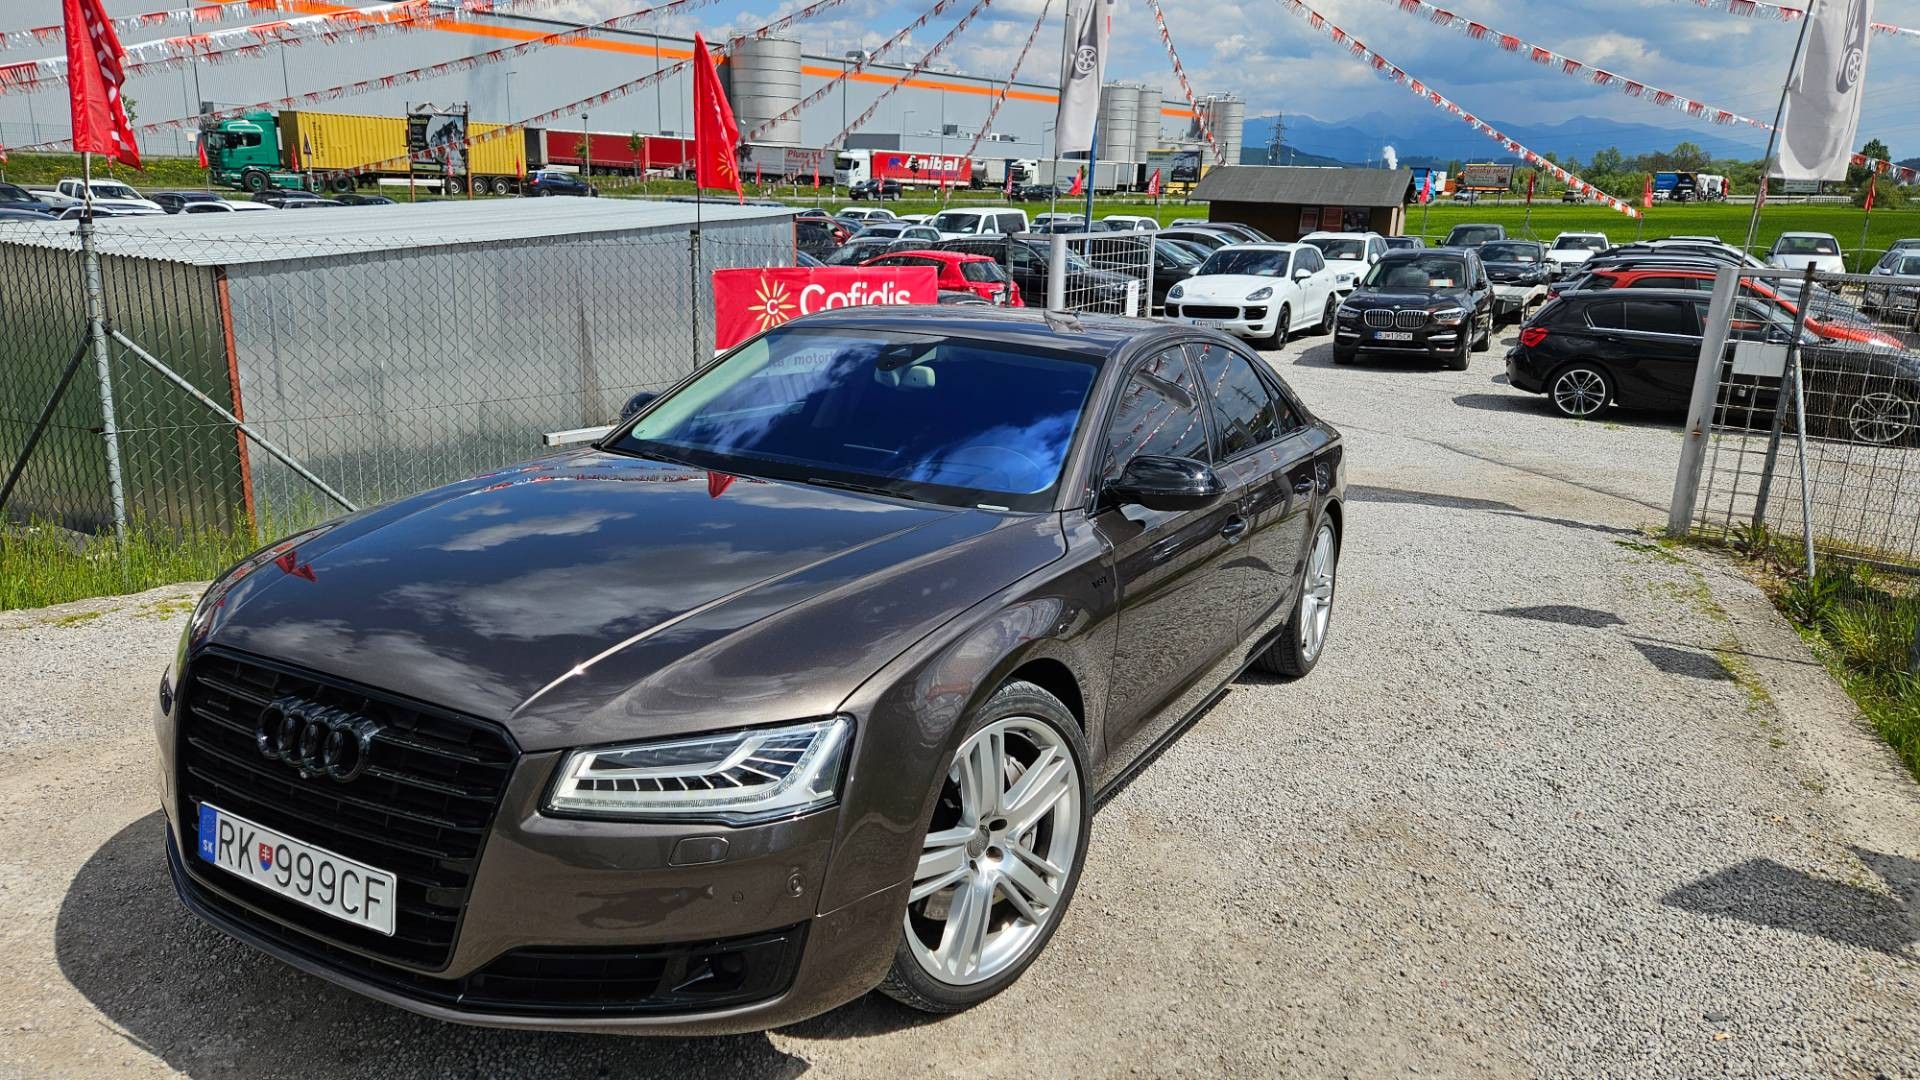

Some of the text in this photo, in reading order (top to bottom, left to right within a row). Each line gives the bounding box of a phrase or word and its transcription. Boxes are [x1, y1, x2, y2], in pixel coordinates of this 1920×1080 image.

[800, 281, 911, 315] Cofidis
[202, 839, 213, 853] SK
[218, 819, 386, 920] RK 999CF
